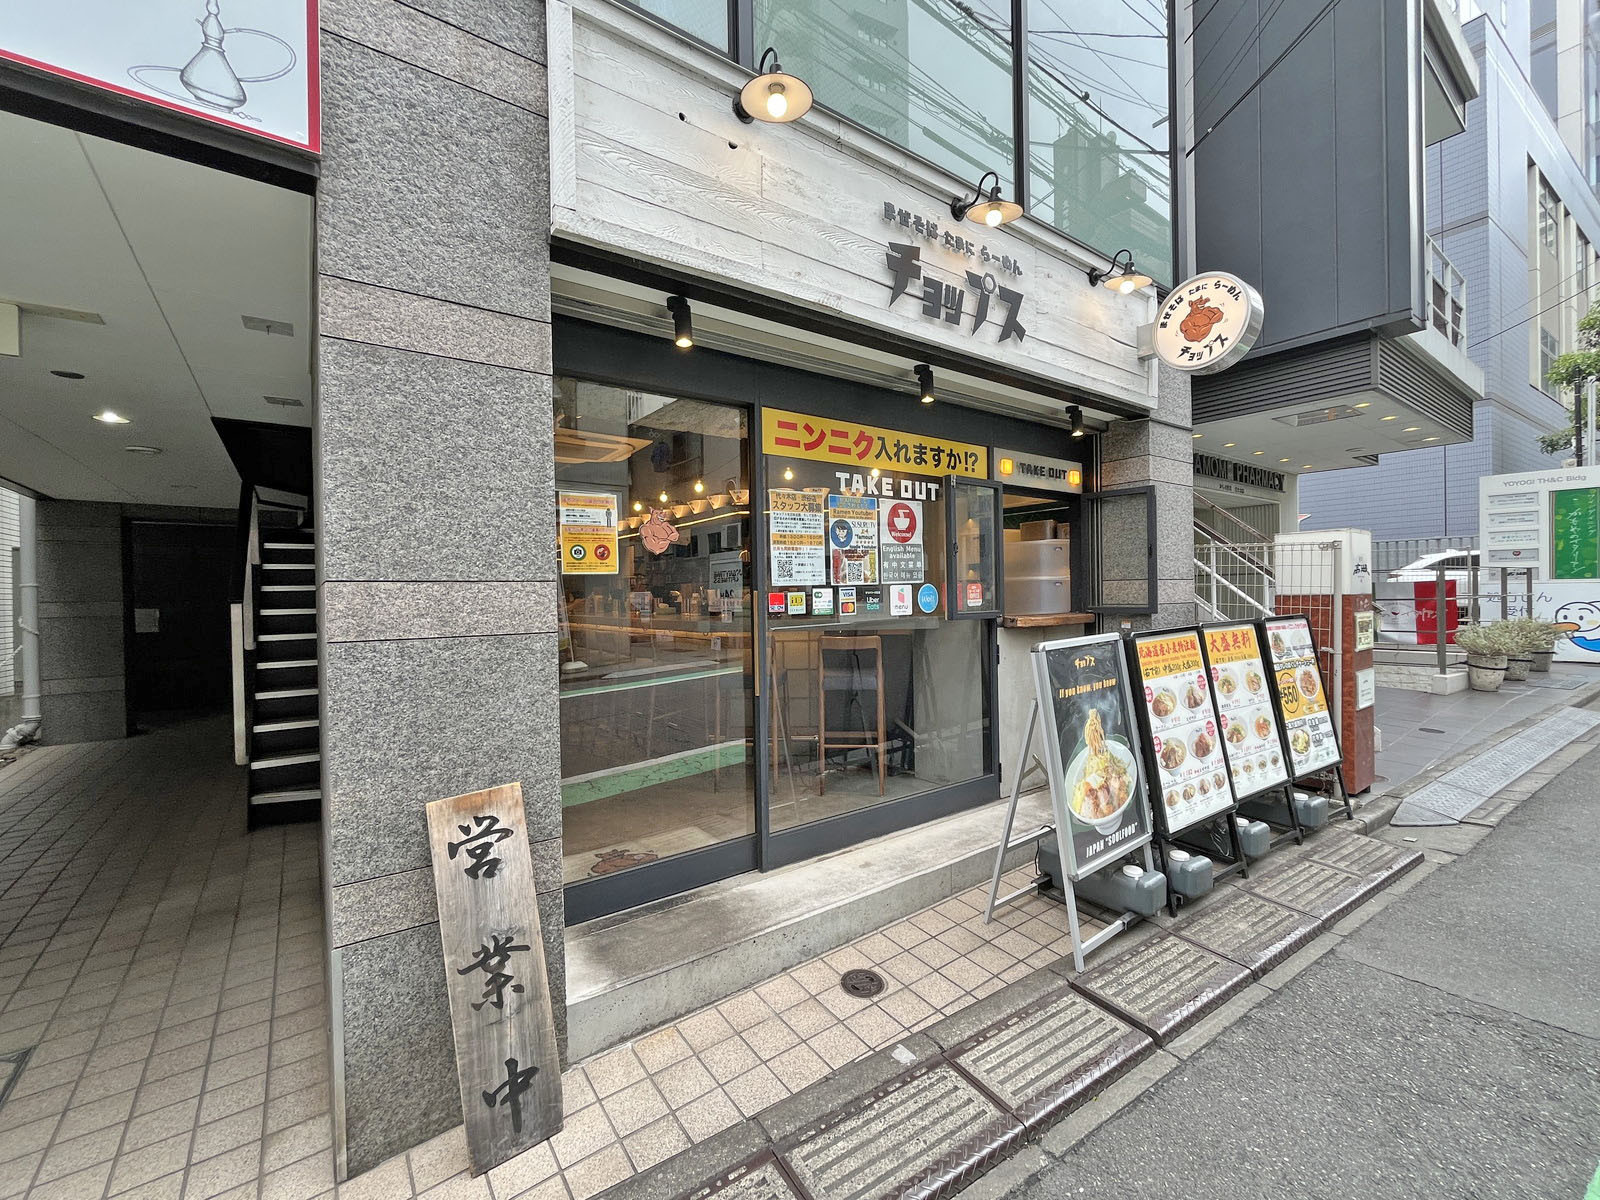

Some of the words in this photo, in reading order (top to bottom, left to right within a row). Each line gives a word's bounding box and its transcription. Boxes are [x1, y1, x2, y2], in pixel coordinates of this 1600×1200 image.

[884, 202, 938, 242] まぜそば
[944, 230, 976, 257] たまに
[980, 244, 1023, 277] らーめん
[886, 242, 1026, 344] チョップス
[1158, 294, 1184, 329] まぜそば
[1188, 283, 1208, 296] たまに
[1214, 280, 1244, 302] らーめん
[1176, 332, 1229, 363] チョップス
[1019, 462, 1046, 477] TAKE
[1048, 467, 1068, 480] OUT
[1234, 462, 1285, 491] PHARMACY
[835, 472, 893, 496] TAKE
[900, 478, 940, 502] OUT
[1210, 630, 1252, 653] 大盛無料
[1065, 688, 1076, 698] you
[1093, 681, 1102, 691] you
[1103, 678, 1116, 688] know
[1086, 839, 1104, 858] JAPAN
[448, 816, 540, 1134] 営業中
